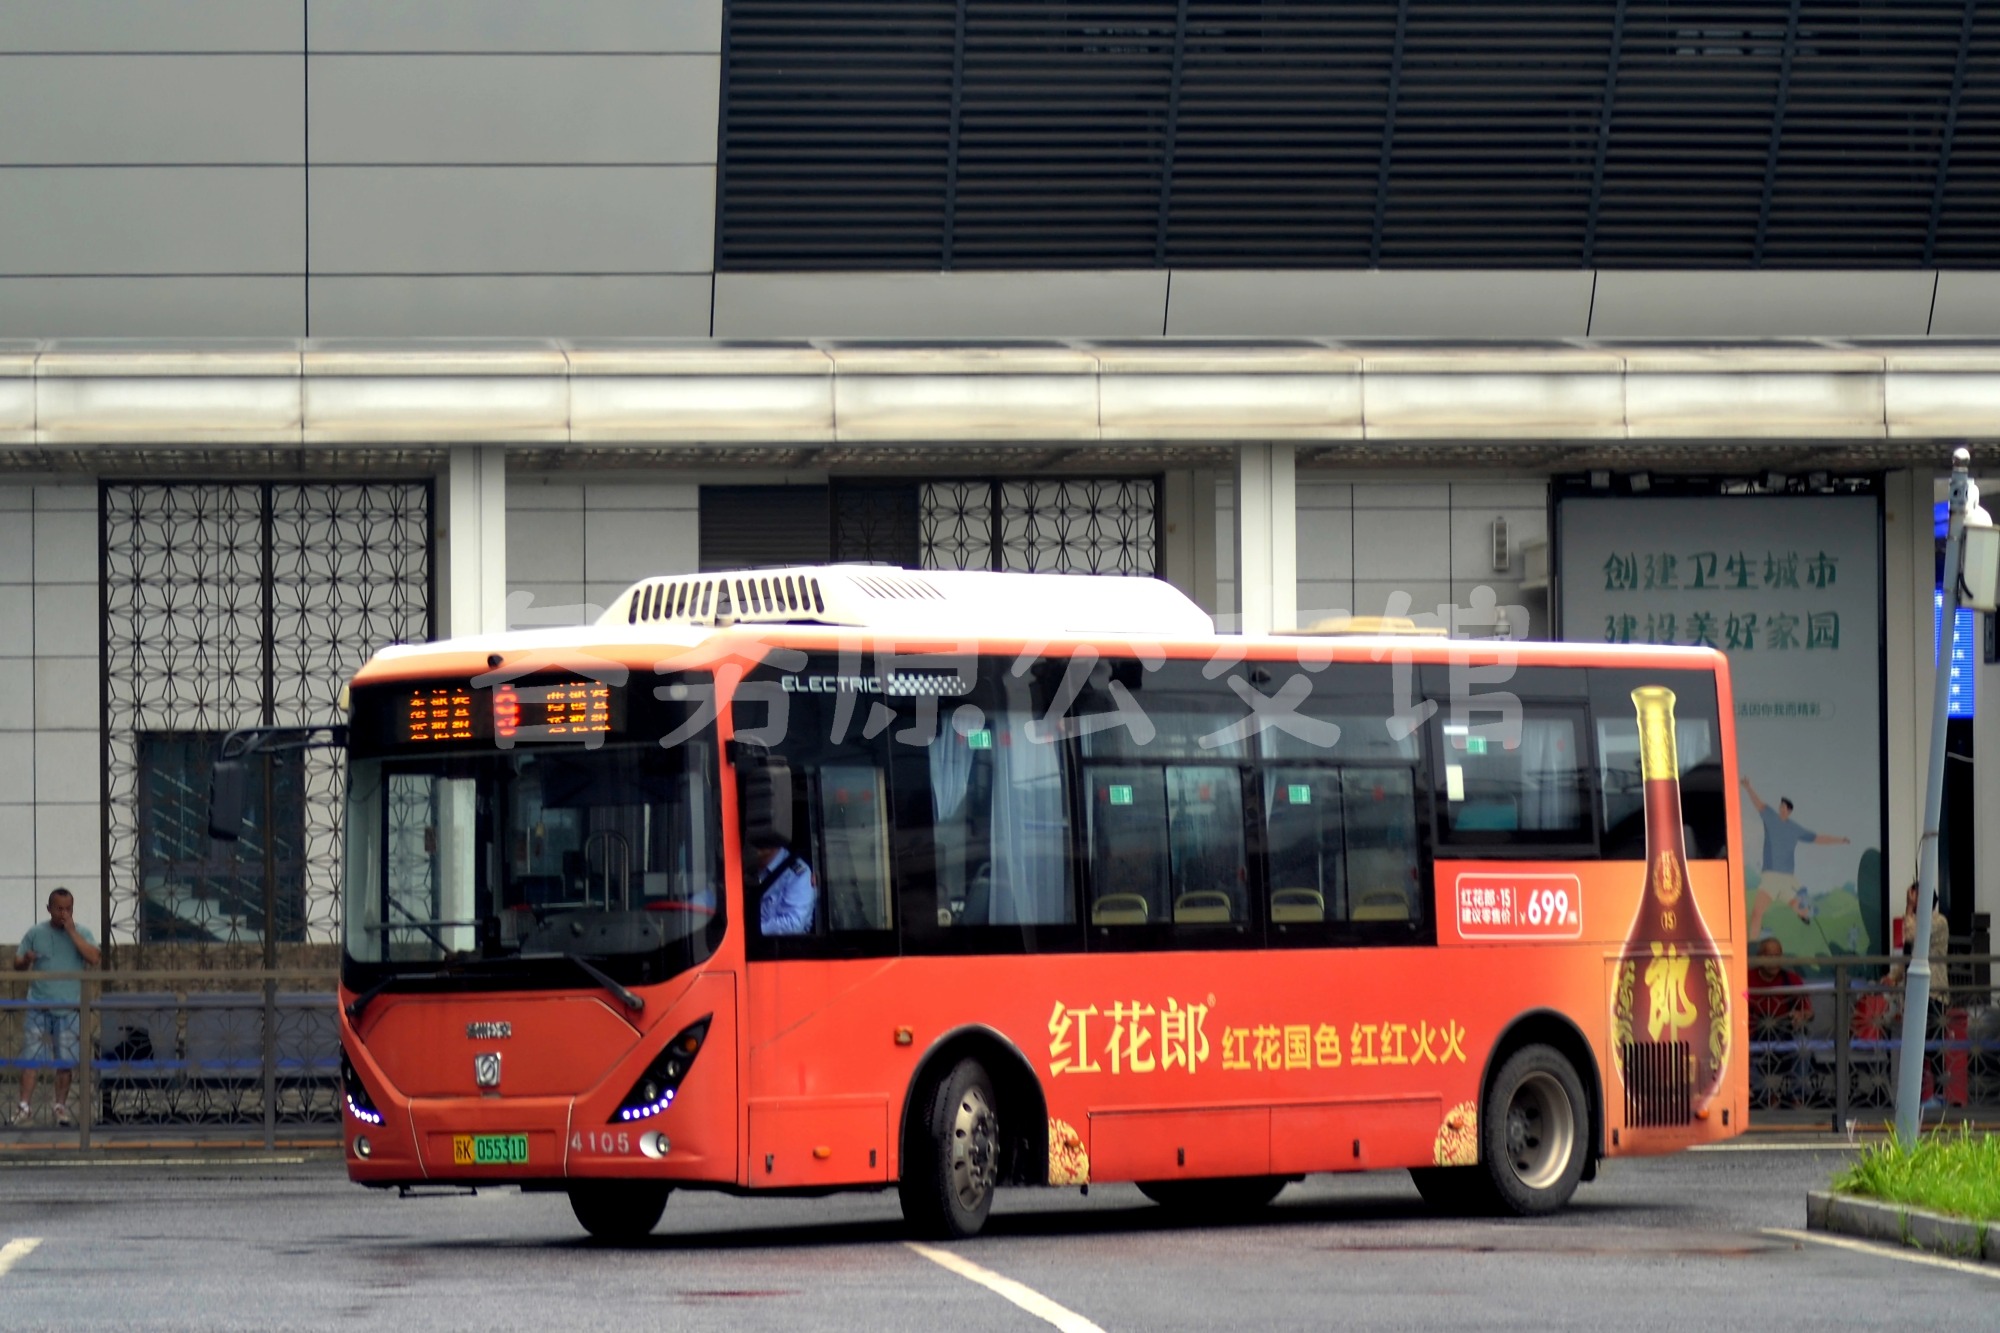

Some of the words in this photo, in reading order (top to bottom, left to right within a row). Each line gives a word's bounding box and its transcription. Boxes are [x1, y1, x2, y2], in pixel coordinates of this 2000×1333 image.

[1602, 550, 1839, 590] 创建卫生城市
[1604, 610, 1840, 650] 建设美好家园
[781, 674, 882, 693] ELECTRIC
[1733, 701, 1821, 717] 活因你我而精彩
[1048, 997, 1211, 1078] 红花郎
[1221, 1022, 1342, 1071] 红花国色
[1350, 1018, 1467, 1066] 红红火火
[570, 1131, 630, 1154] 4105
